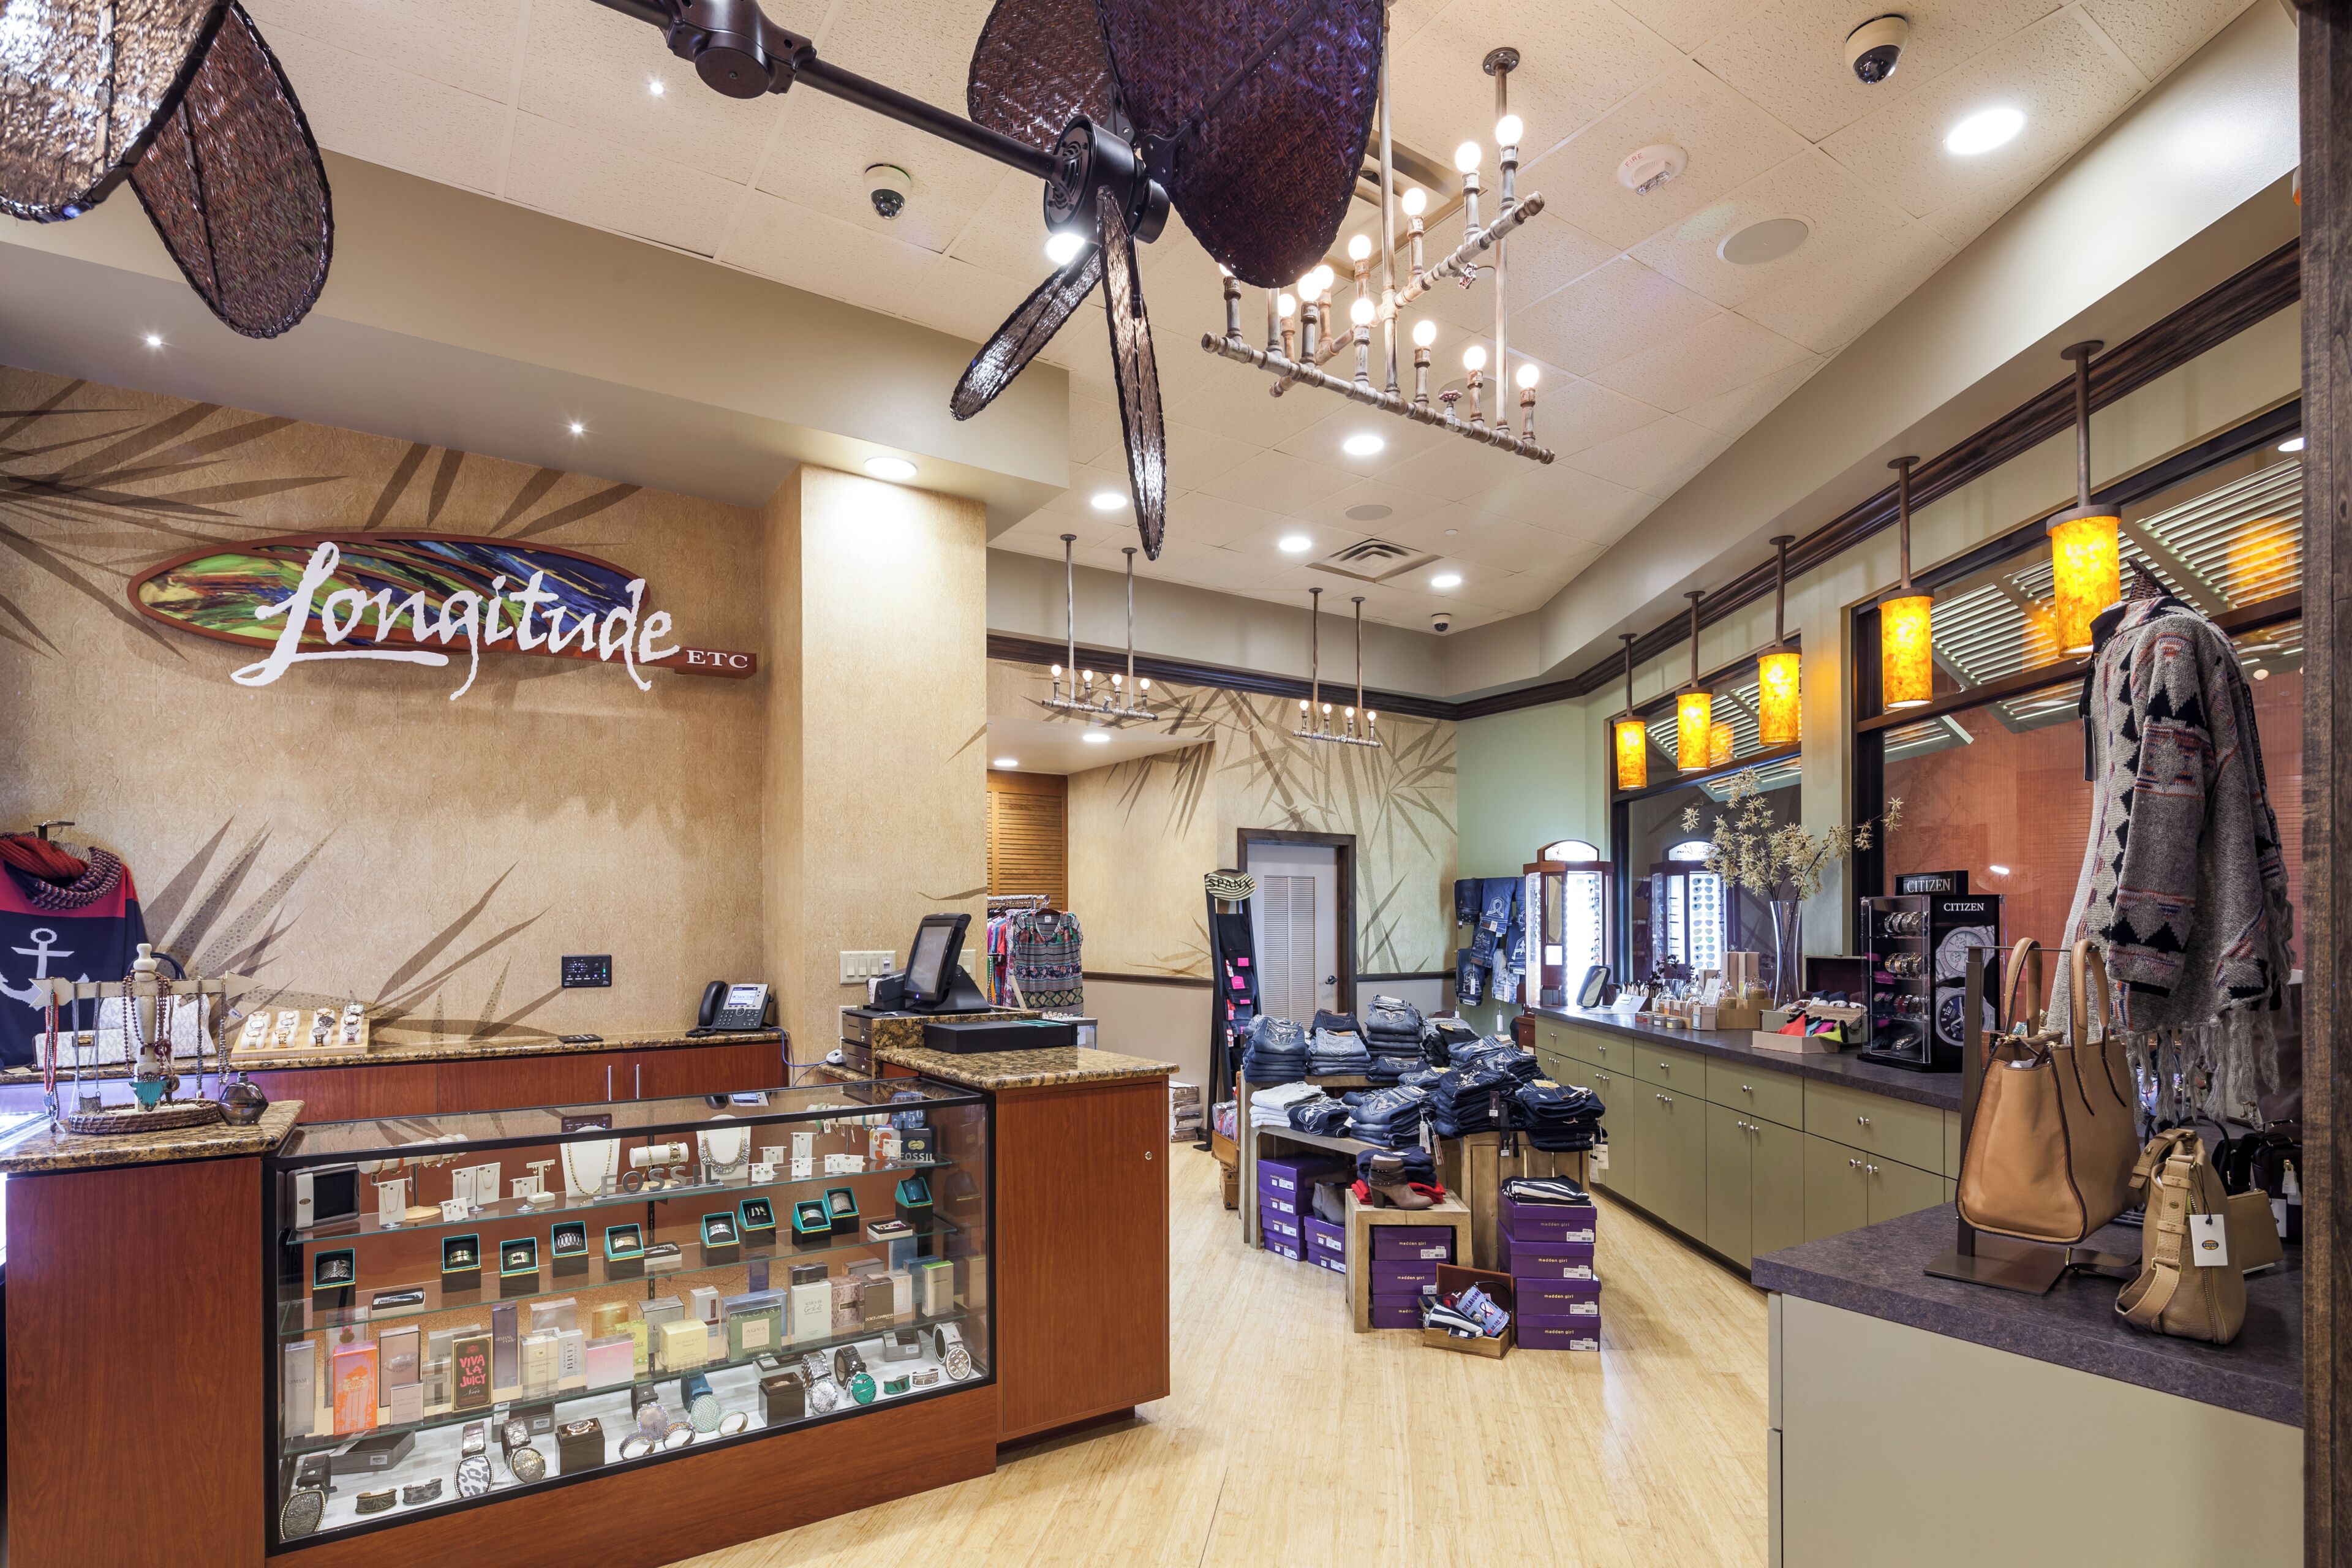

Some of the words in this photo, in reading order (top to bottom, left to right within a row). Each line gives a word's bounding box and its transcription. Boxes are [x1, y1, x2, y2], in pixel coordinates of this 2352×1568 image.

[1625, 153, 1643, 167] FIRE
[230, 541, 680, 701] Longitude
[686, 649, 750, 669] ETC
[1208, 878, 1251, 889] SPANX
[1907, 878, 1951, 893] CITIZEN
[1943, 903, 1985, 911] CITIZEN
[601, 1164, 720, 1197] FOSSIL
[459, 1354, 486, 1368] VIVA
[466, 1365, 482, 1375] LA
[460, 1374, 486, 1387] JUICY
